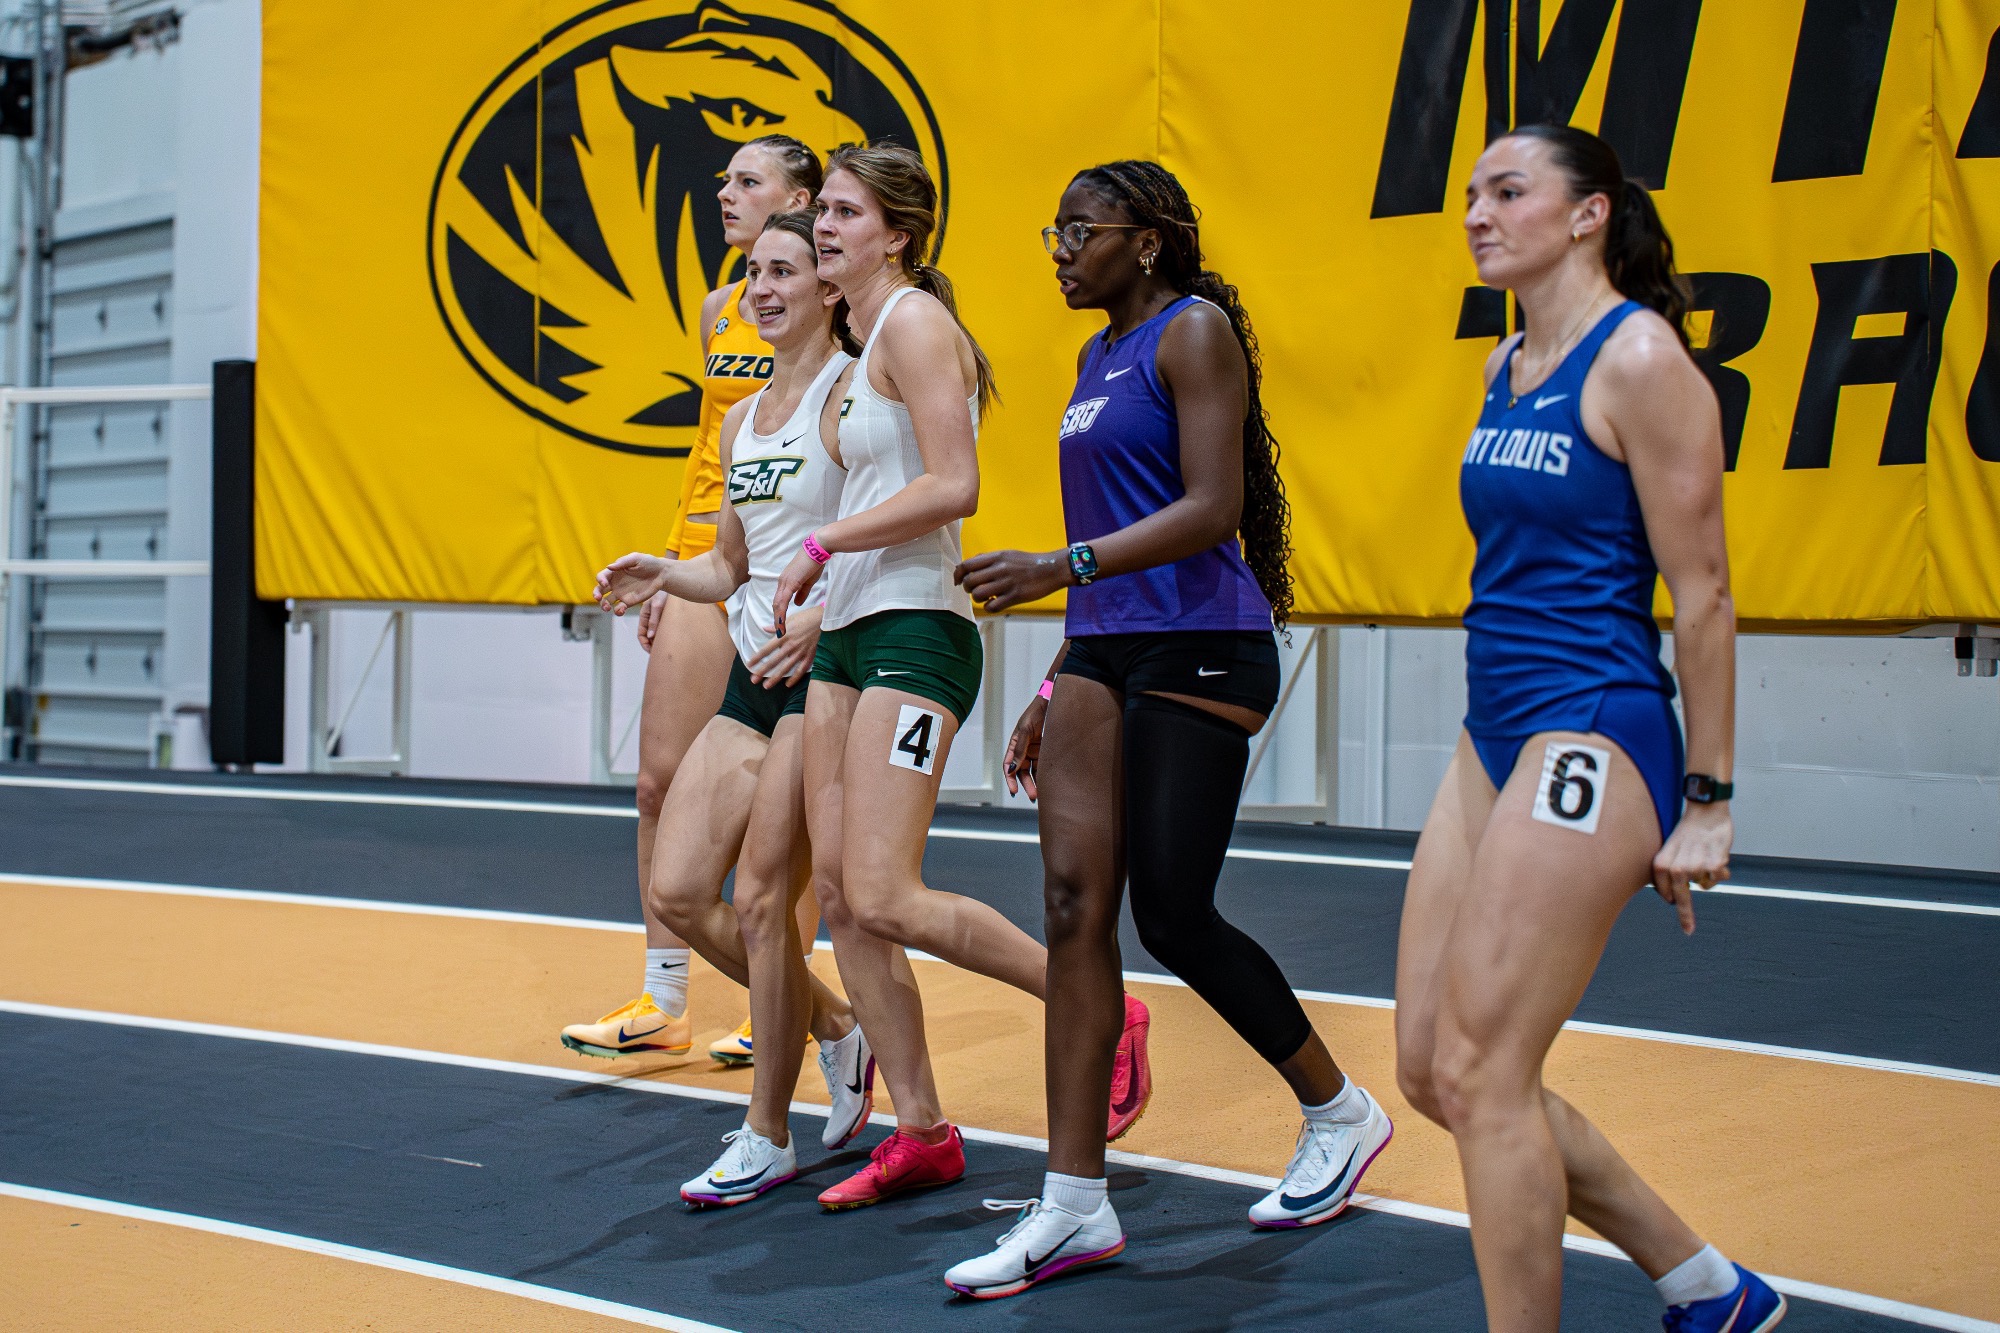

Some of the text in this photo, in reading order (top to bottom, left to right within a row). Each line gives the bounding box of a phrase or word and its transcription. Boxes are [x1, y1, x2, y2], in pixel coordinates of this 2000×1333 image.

[705, 354, 774, 379] IZZO
[1455, 248, 2000, 472] RA
[1488, 428, 1573, 477] LOUIS
[728, 457, 805, 505] S&T
[897, 713, 933, 768] 4
[1548, 751, 1597, 820] 6
